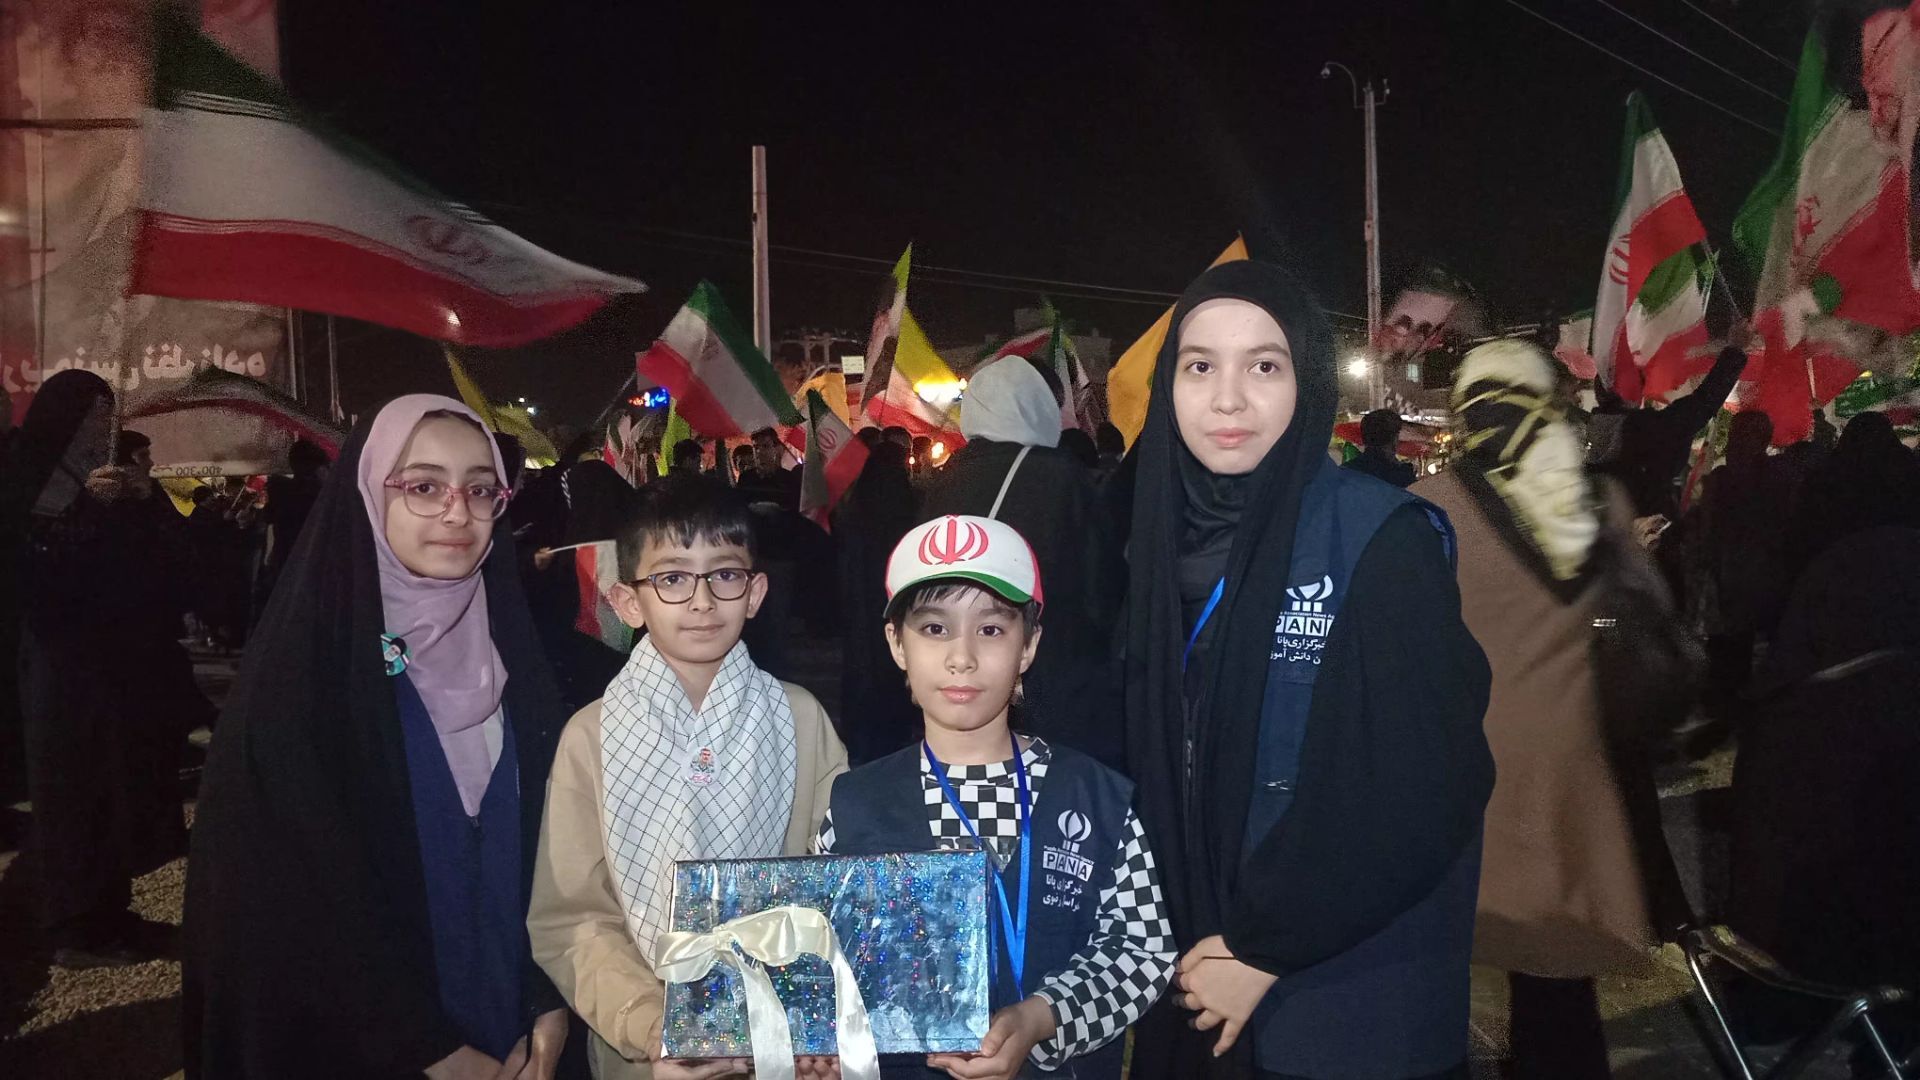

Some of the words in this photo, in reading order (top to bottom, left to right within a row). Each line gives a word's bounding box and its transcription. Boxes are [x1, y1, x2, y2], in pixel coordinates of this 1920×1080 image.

[1275, 617, 1324, 635] PAN
[1288, 651, 1311, 662] دانش
[1045, 852, 1089, 880] PANA
